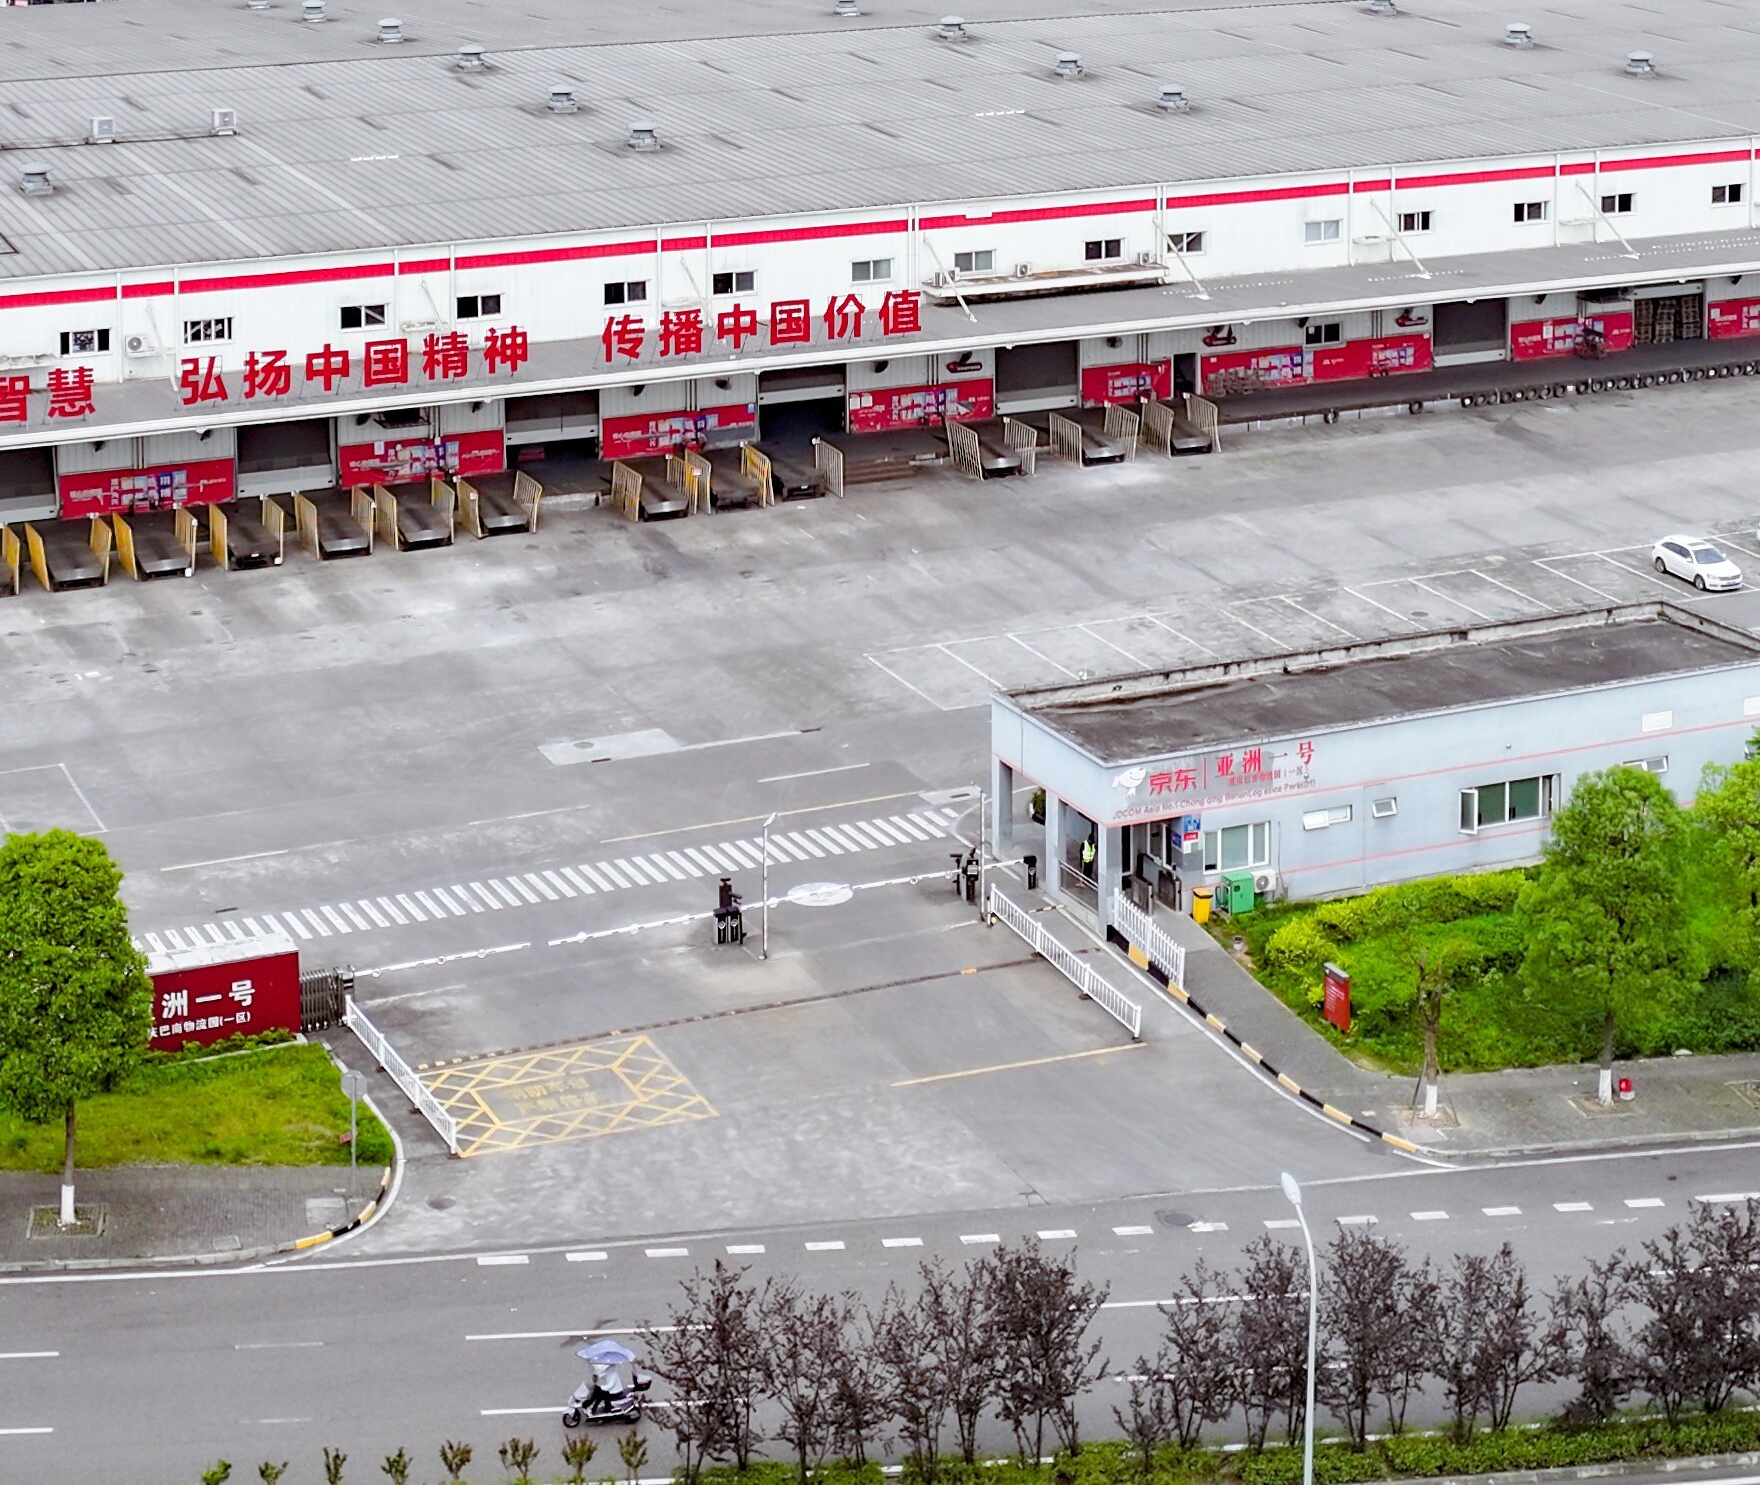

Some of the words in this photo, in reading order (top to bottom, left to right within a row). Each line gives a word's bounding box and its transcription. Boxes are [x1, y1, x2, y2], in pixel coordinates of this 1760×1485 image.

[180, 325, 529, 406] 弘扬中国精神
[602, 289, 922, 363] 传播中国价值
[1149, 768, 1198, 796] 京东
[1215, 741, 1315, 778] 亚洲一号
[151, 979, 256, 1019] 洲一号
